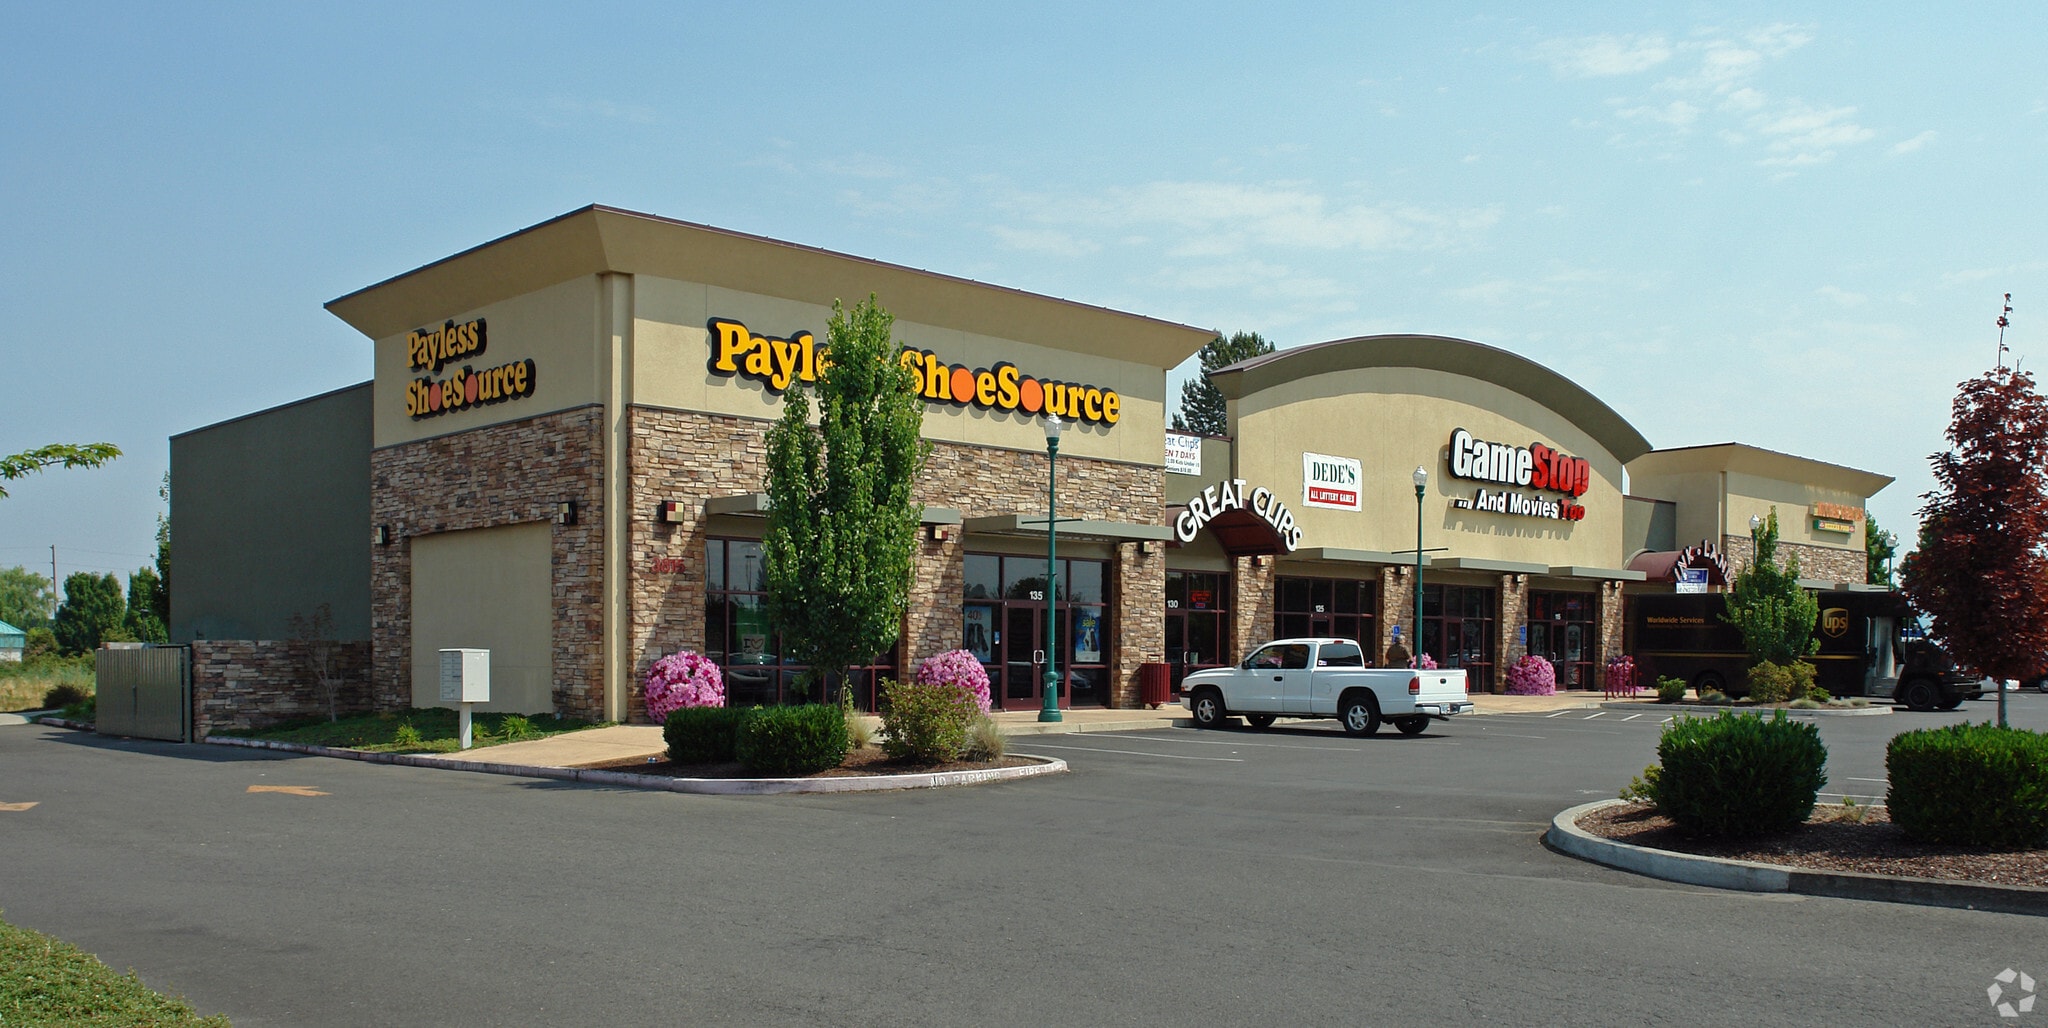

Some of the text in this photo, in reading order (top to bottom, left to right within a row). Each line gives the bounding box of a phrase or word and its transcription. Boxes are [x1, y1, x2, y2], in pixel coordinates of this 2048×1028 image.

[405, 319, 485, 372] Payless
[405, 361, 530, 418] ShoeSource
[1178, 435, 1199, 451] Clips
[1175, 450, 1179, 458] 7
[1180, 451, 1196, 460] DAYS
[1452, 429, 1590, 497] GameStop
[1312, 461, 1355, 485] DEDE'S
[1310, 489, 1319, 500] ALL
[1476, 488, 1507, 514] And
[1509, 492, 1559, 519] Movies
[1561, 499, 1586, 521] Too
[1176, 478, 1303, 551] GREAT CLIPS
[1029, 590, 1043, 600] 135
[1166, 599, 1179, 608] 130
[1647, 616, 1705, 624] Worldwide Services
[1824, 616, 1847, 634] ups
[930, 774, 947, 787] NO
[952, 771, 1000, 786] PARKING
